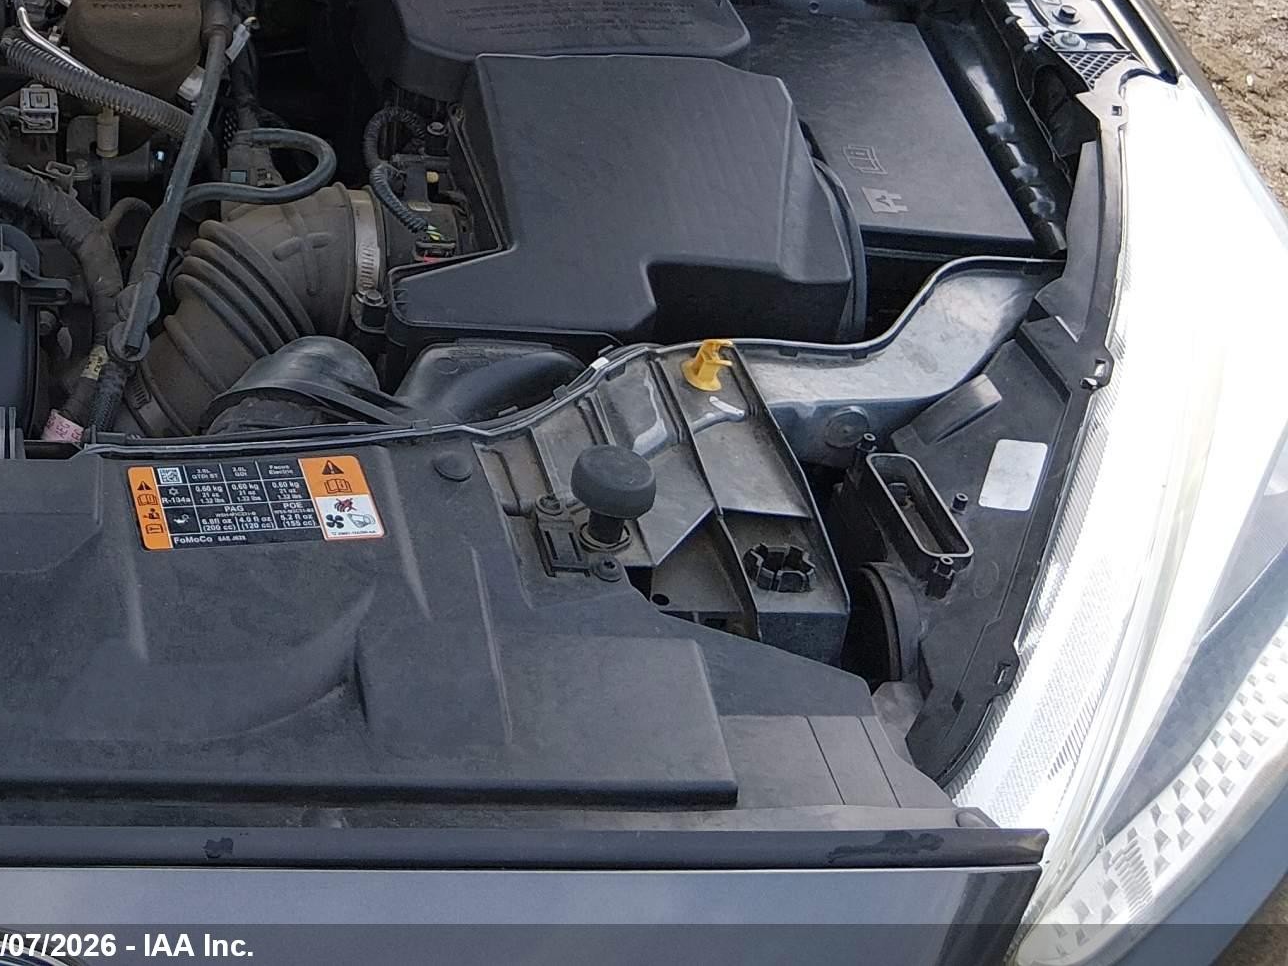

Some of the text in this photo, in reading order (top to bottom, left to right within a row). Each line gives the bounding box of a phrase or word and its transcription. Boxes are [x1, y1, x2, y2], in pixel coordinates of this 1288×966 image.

[212, 485, 223, 493] kg
[162, 496, 191, 504] R-134a
[202, 524, 222, 532] (200
[174, 535, 213, 544] FoMoCo
